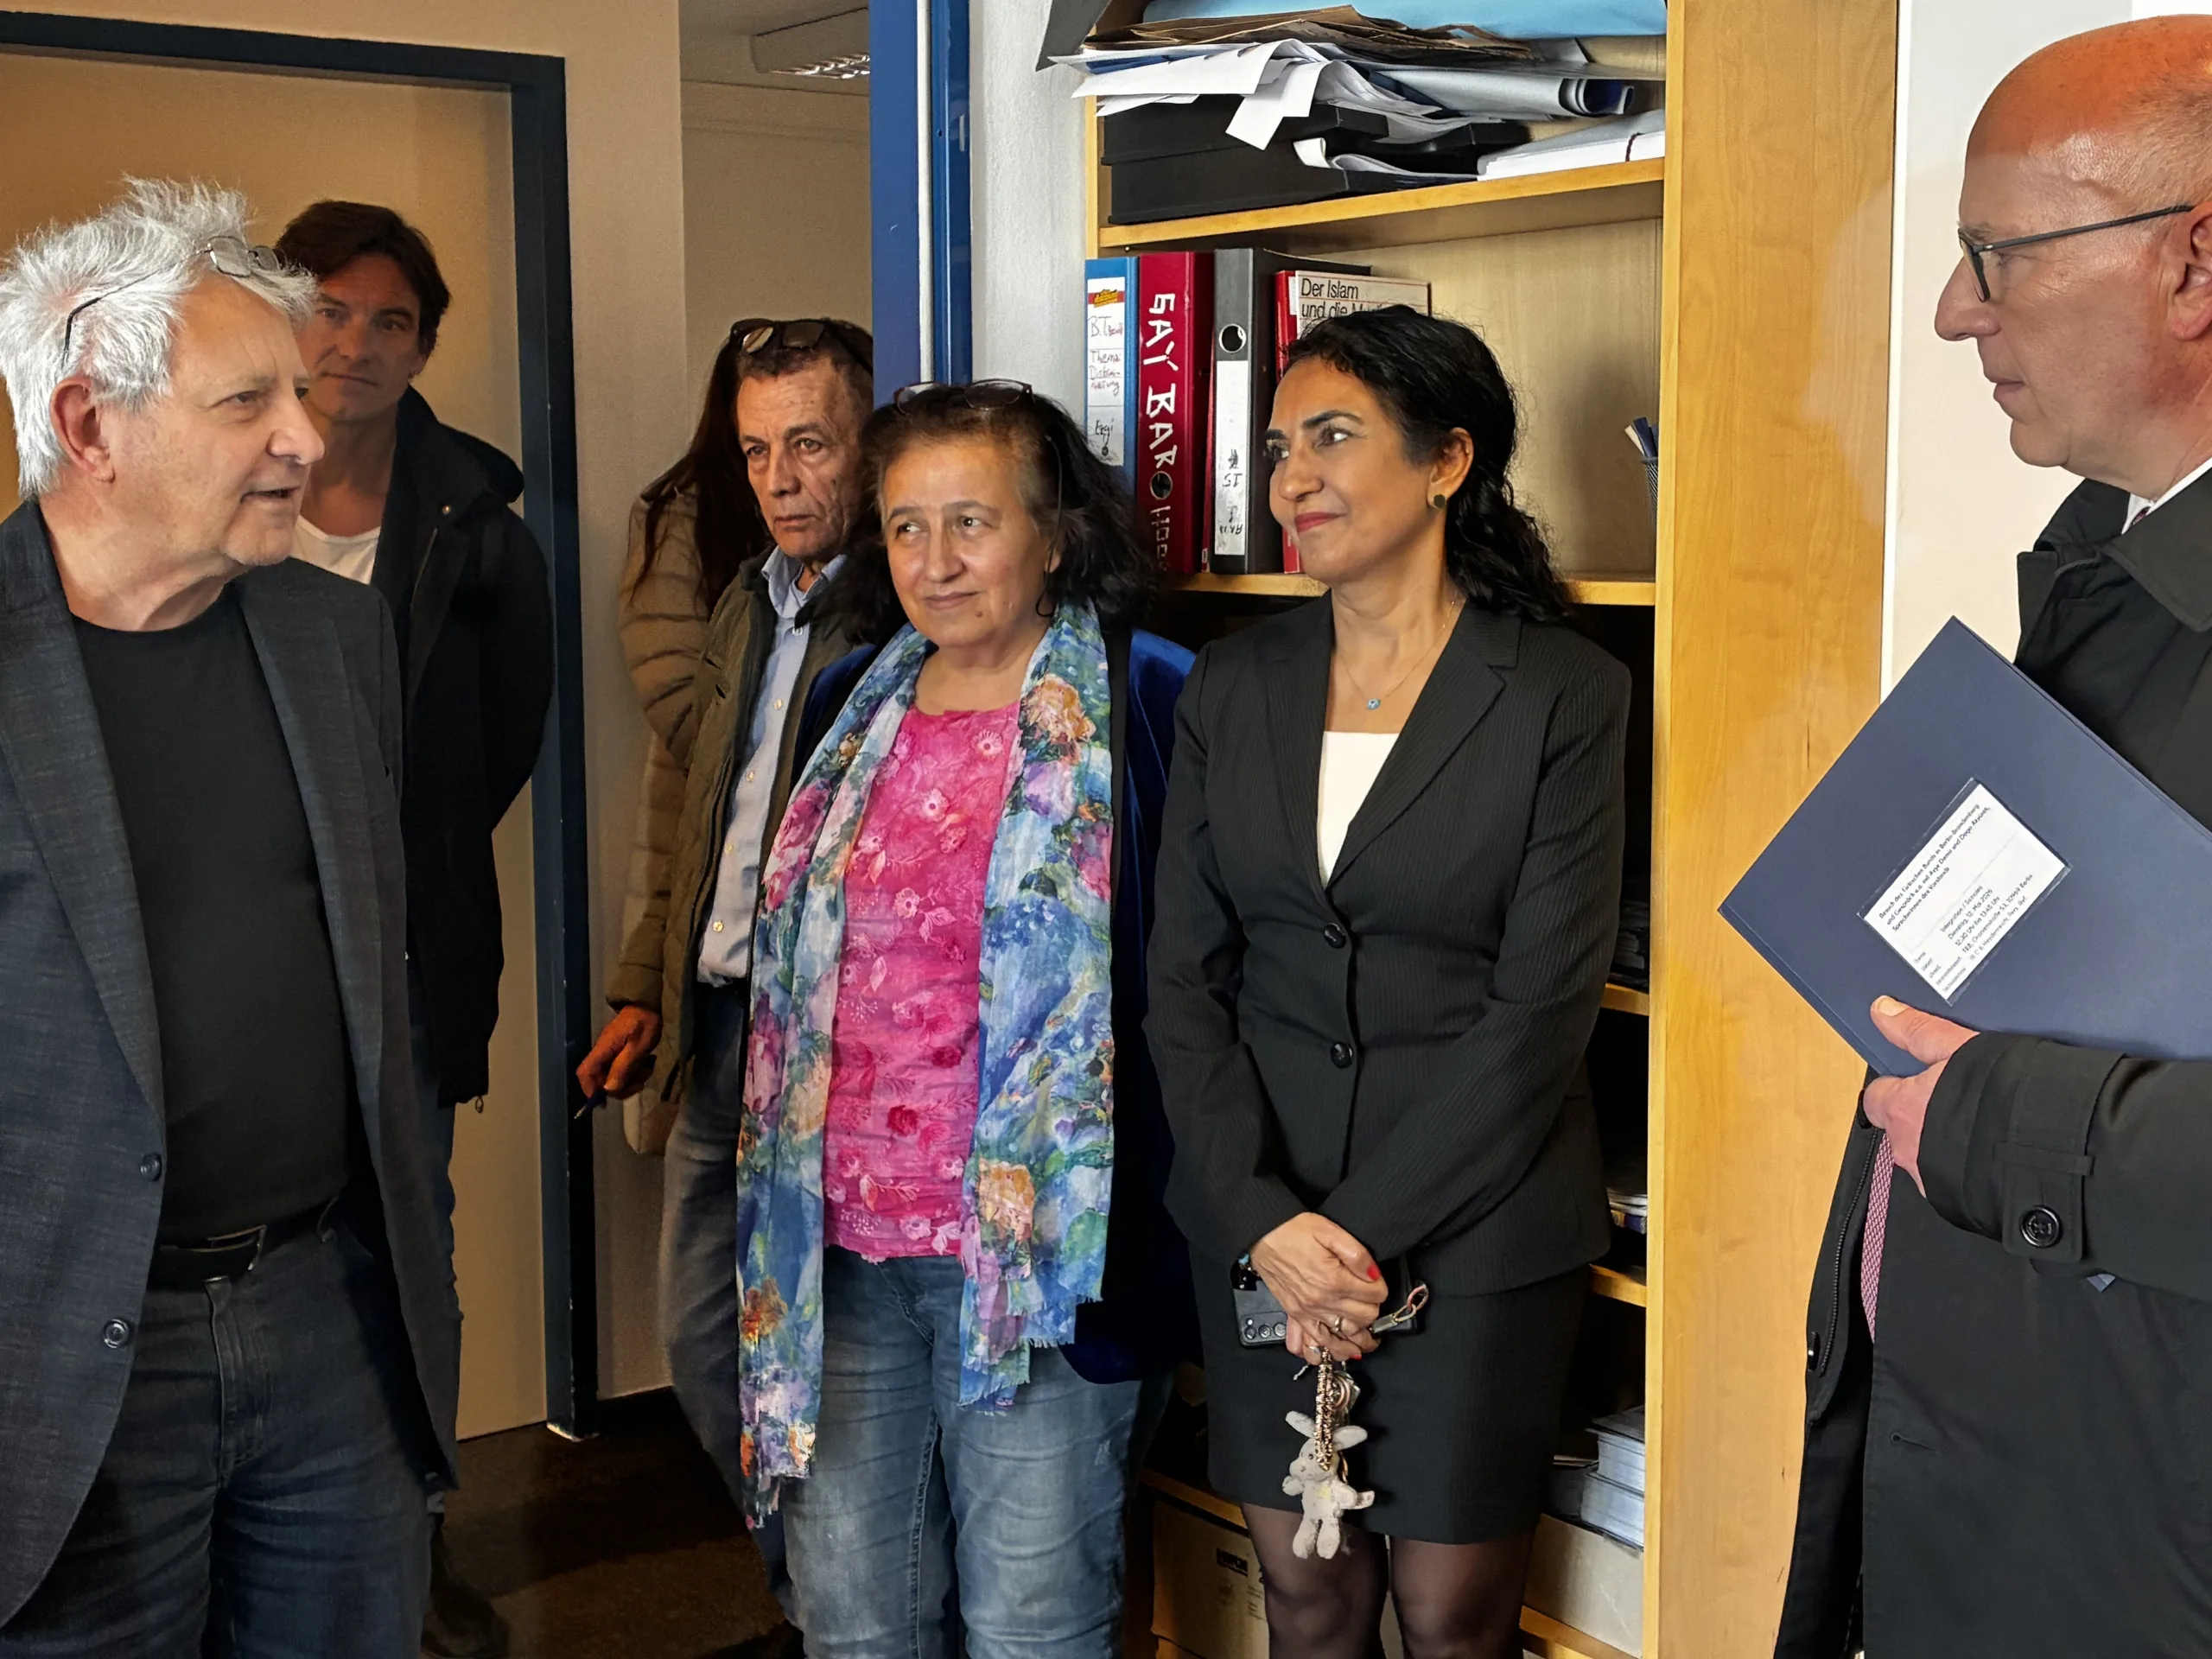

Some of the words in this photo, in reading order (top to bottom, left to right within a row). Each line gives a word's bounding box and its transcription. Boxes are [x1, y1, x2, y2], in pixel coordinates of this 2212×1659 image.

[1301, 278, 1325, 296] Der
[1327, 280, 1358, 299] Islam
[1302, 302, 1326, 318] und
[1329, 302, 1348, 318] die
[1146, 383, 1177, 469] BAR
